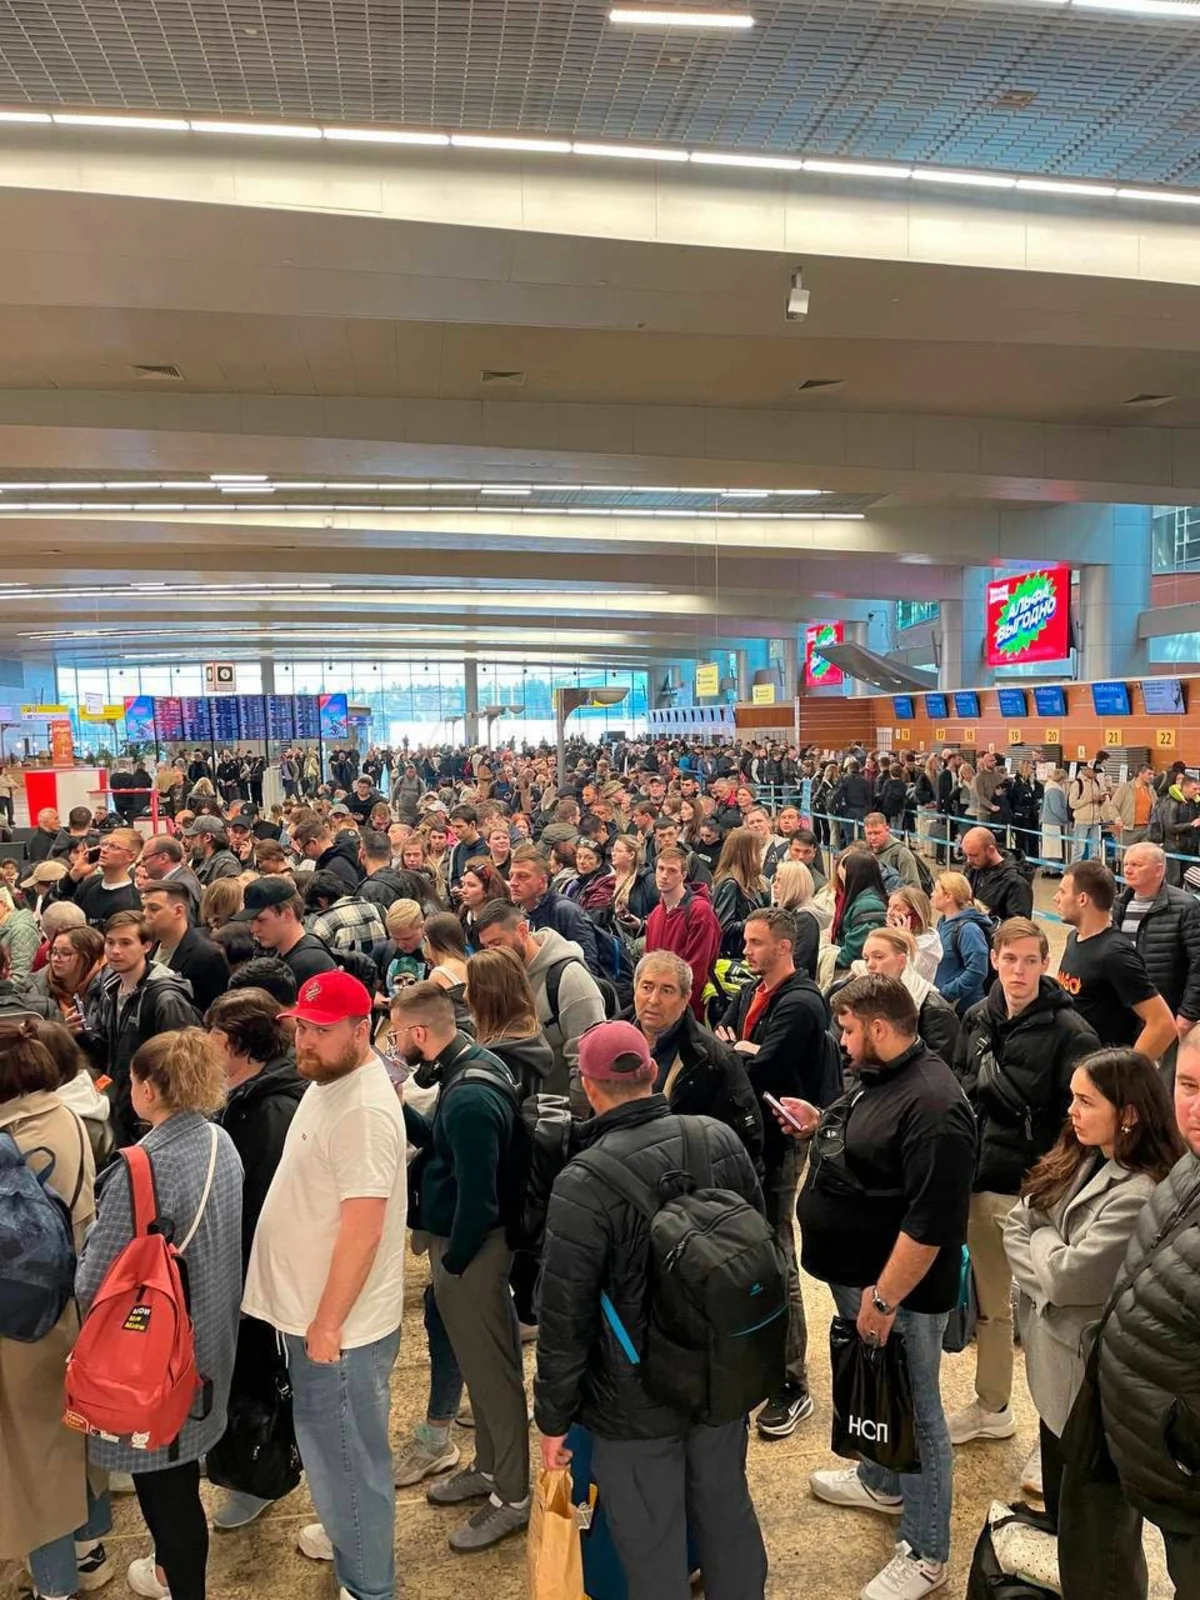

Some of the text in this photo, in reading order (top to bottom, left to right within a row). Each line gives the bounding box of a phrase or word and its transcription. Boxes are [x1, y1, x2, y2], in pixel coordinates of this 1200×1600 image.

[996, 596, 1057, 642] ВЫГОДНО
[1011, 730, 1019, 741] 19
[1048, 731, 1057, 742] 20
[1108, 732, 1118, 744] 21
[1159, 732, 1172, 745] 22
[848, 1414, 888, 1443] НСП
